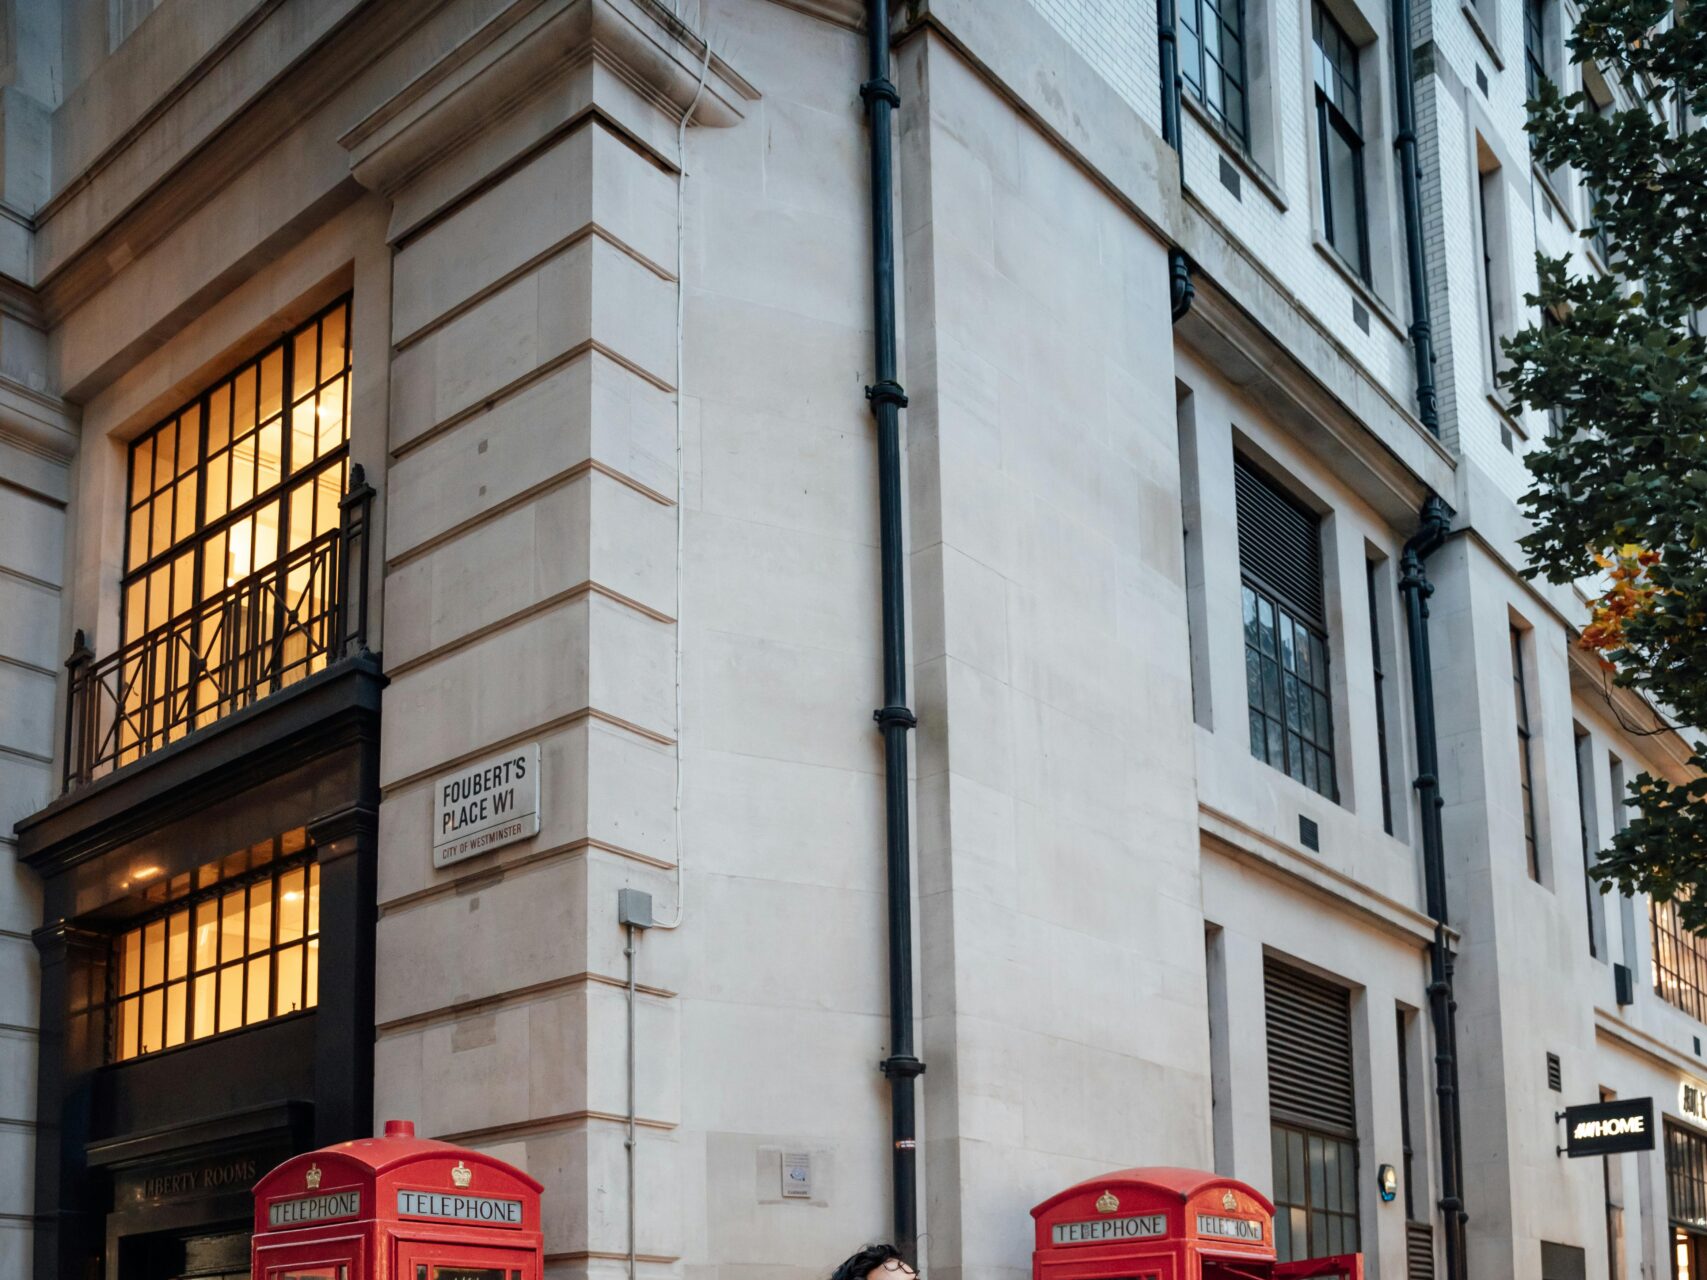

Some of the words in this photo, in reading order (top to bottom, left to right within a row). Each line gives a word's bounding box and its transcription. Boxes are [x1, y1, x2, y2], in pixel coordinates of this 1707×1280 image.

[443, 756, 526, 807] FOUBERT'S
[443, 797, 488, 834] PLACE
[493, 788, 514, 815] W1
[442, 844, 457, 859] CITY
[460, 842, 469, 853] OF
[470, 823, 522, 849] WESTMINSTER
[144, 1171, 198, 1197] LIBERTY
[203, 1160, 256, 1187] ROOMS
[273, 1192, 358, 1223] TELEPHONE
[401, 1193, 517, 1221] TELEPHONE
[1056, 1216, 1162, 1241] TELEPHONE
